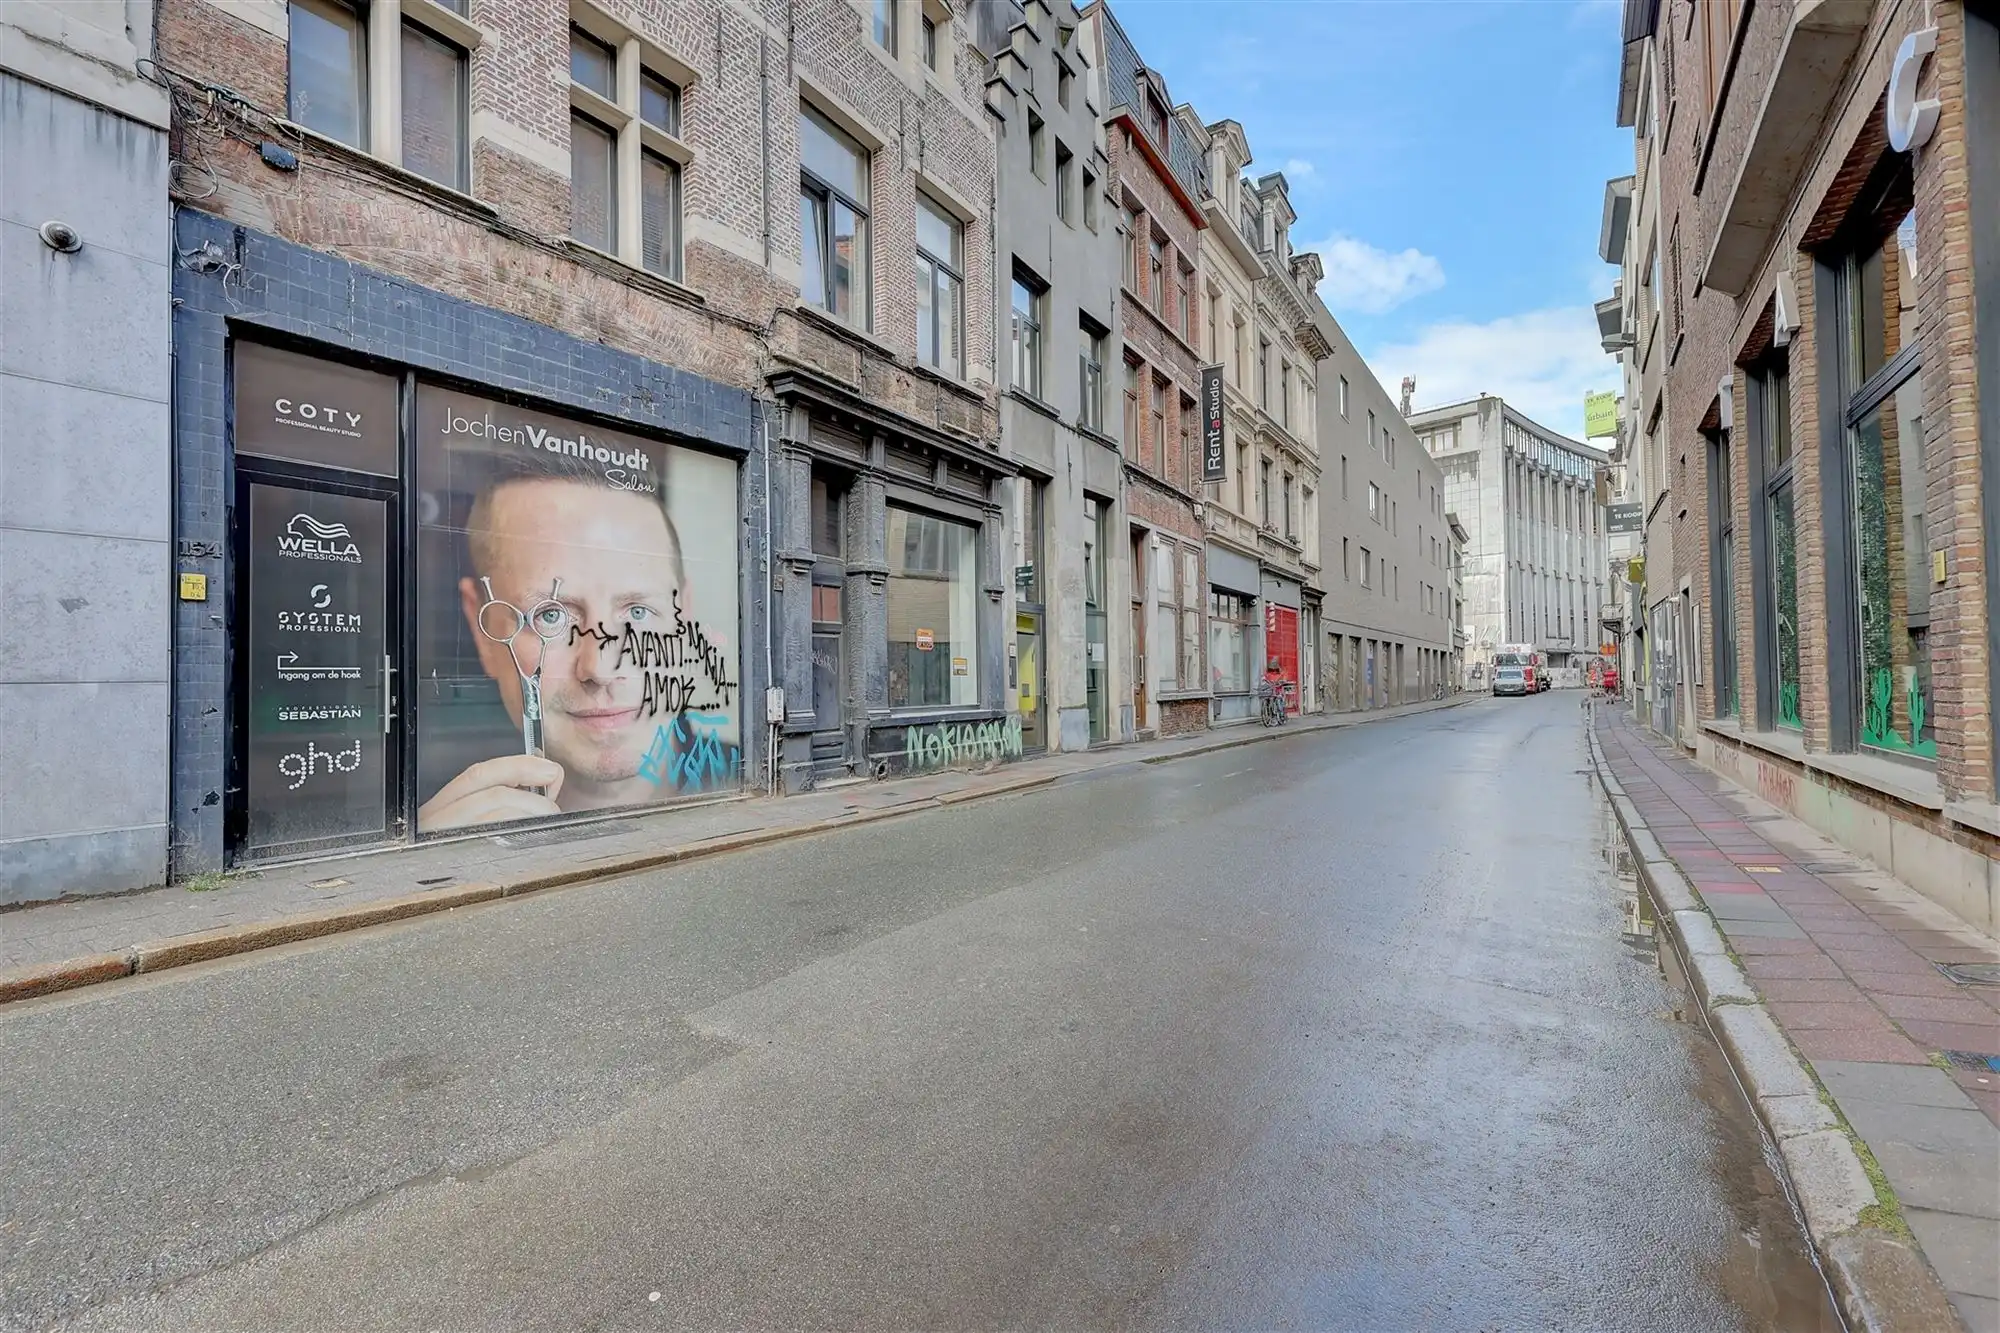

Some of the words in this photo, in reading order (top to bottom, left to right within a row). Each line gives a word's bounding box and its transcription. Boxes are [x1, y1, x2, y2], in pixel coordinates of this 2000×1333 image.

[275, 398, 361, 427] COTY
[275, 417, 319, 430] PROFESSIONAL
[319, 425, 341, 434] BEAUTY
[341, 429, 362, 438] STUDIO
[604, 469, 656, 493] Salon
[277, 536, 361, 557] WELLA
[278, 550, 362, 564] PROFESSIONALS
[278, 611, 361, 626] SYSTEM
[278, 624, 361, 633] PROFESSIONAL
[278, 671, 310, 681] Ingang
[311, 672, 326, 680] om
[327, 670, 339, 680] de
[340, 670, 361, 680] hoek
[278, 709, 361, 721] SEBASTIAN
[278, 739, 361, 790] ghd
